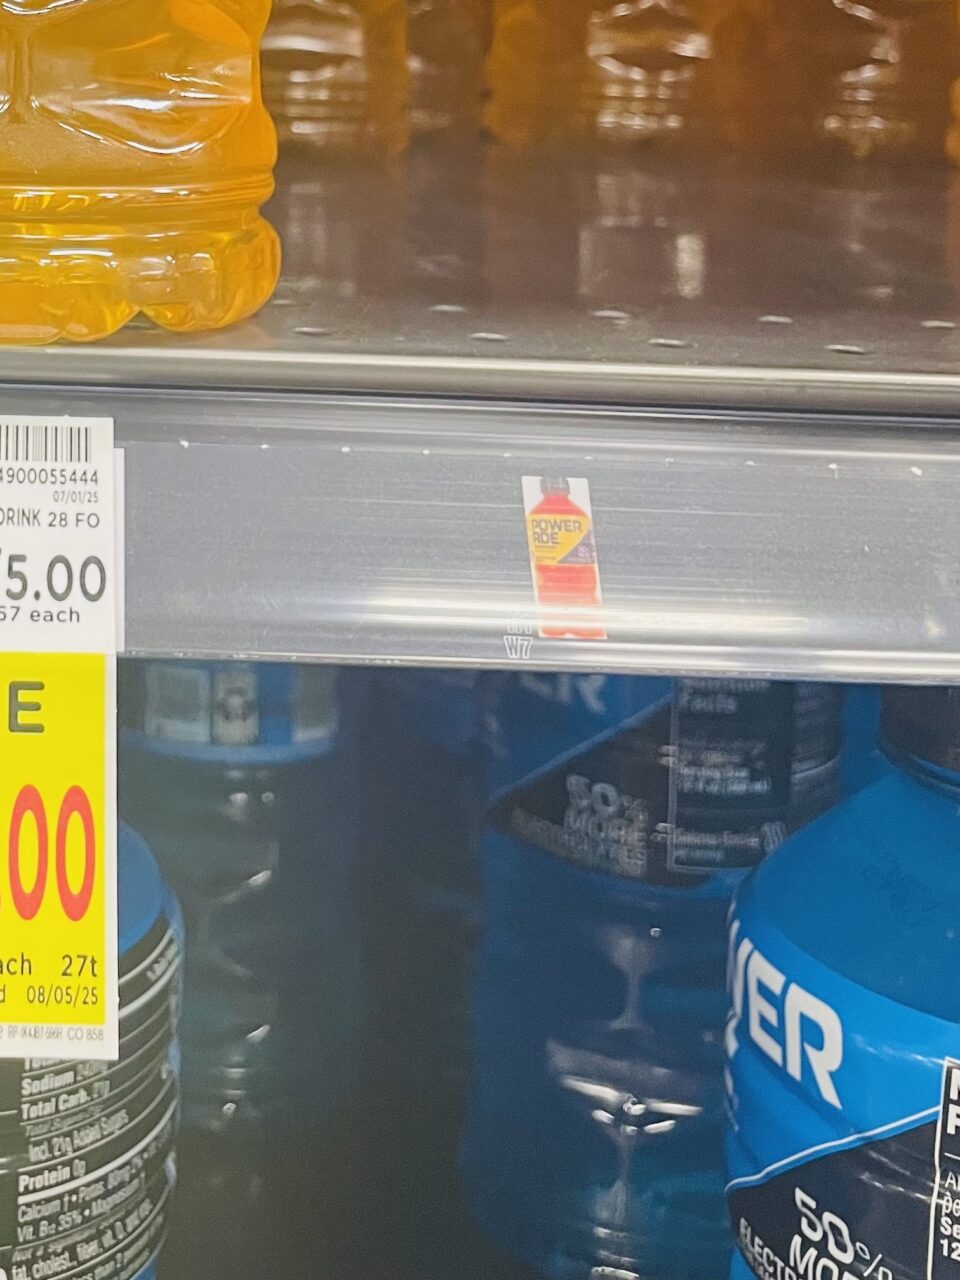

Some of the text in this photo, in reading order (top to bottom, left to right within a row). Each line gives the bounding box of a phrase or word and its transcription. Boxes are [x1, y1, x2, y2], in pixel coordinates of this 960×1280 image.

[52, 490, 99, 504] 07/01/25
[47, 511, 69, 528] 28
[74, 512, 100, 528] FO
[30, 605, 81, 623] each
[61, 954, 99, 978] 27t
[26, 984, 99, 1008] 08/05/25
[795, 1187, 894, 1280] 50%
